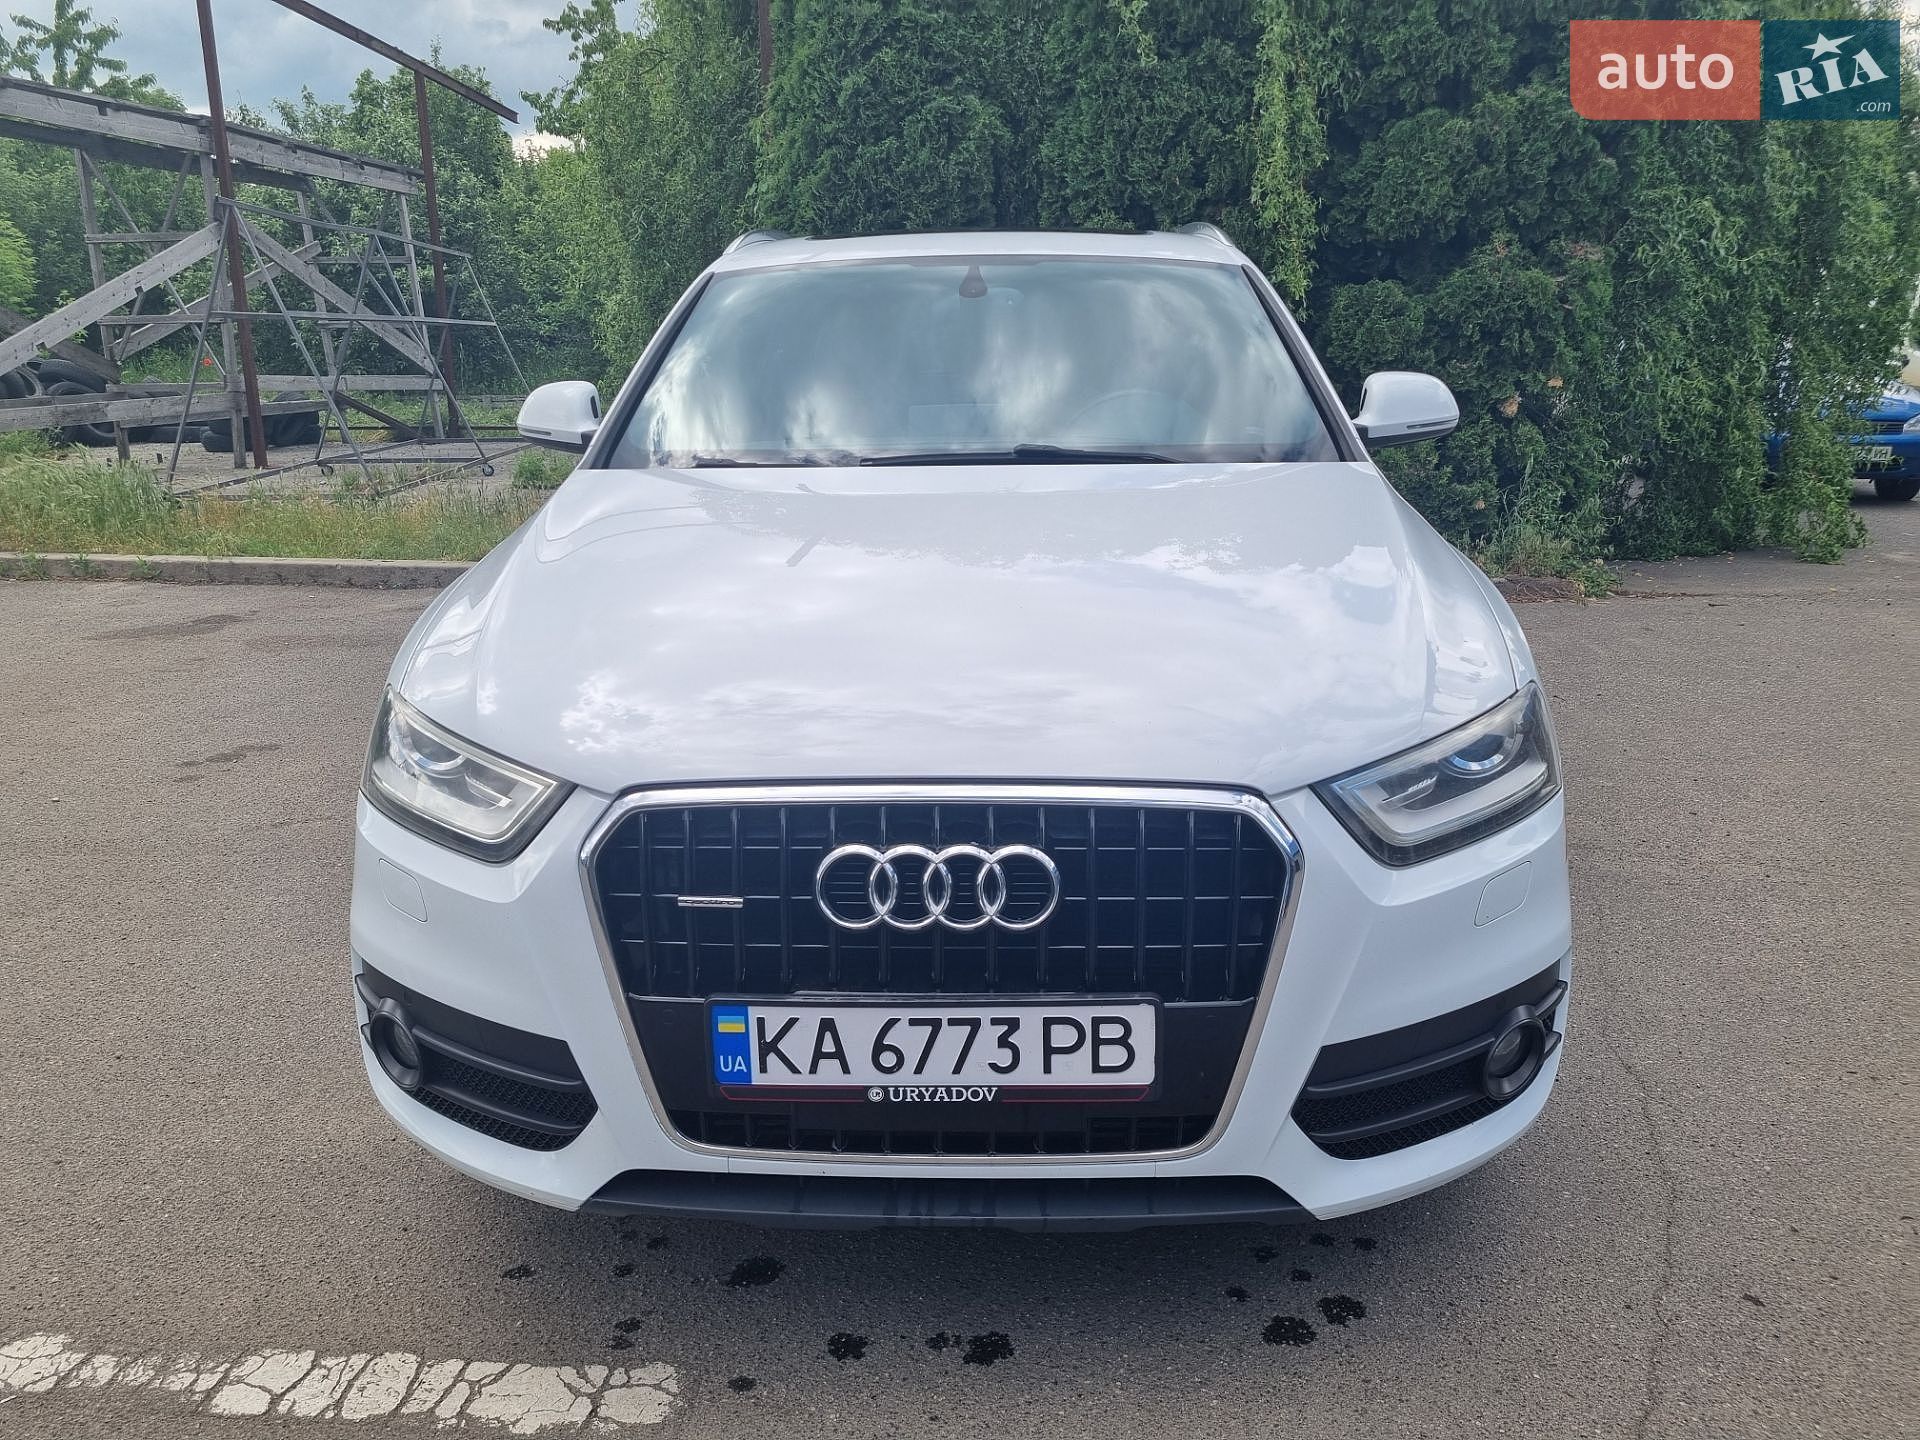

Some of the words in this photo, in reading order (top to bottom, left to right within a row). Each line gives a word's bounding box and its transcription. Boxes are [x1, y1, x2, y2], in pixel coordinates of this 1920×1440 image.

[756, 1016, 851, 1075] KA
[871, 1017, 1021, 1075] 6773
[1042, 1016, 1137, 1076] PB
[720, 1055, 747, 1073] UA
[888, 1086, 998, 1102] URYADOV
